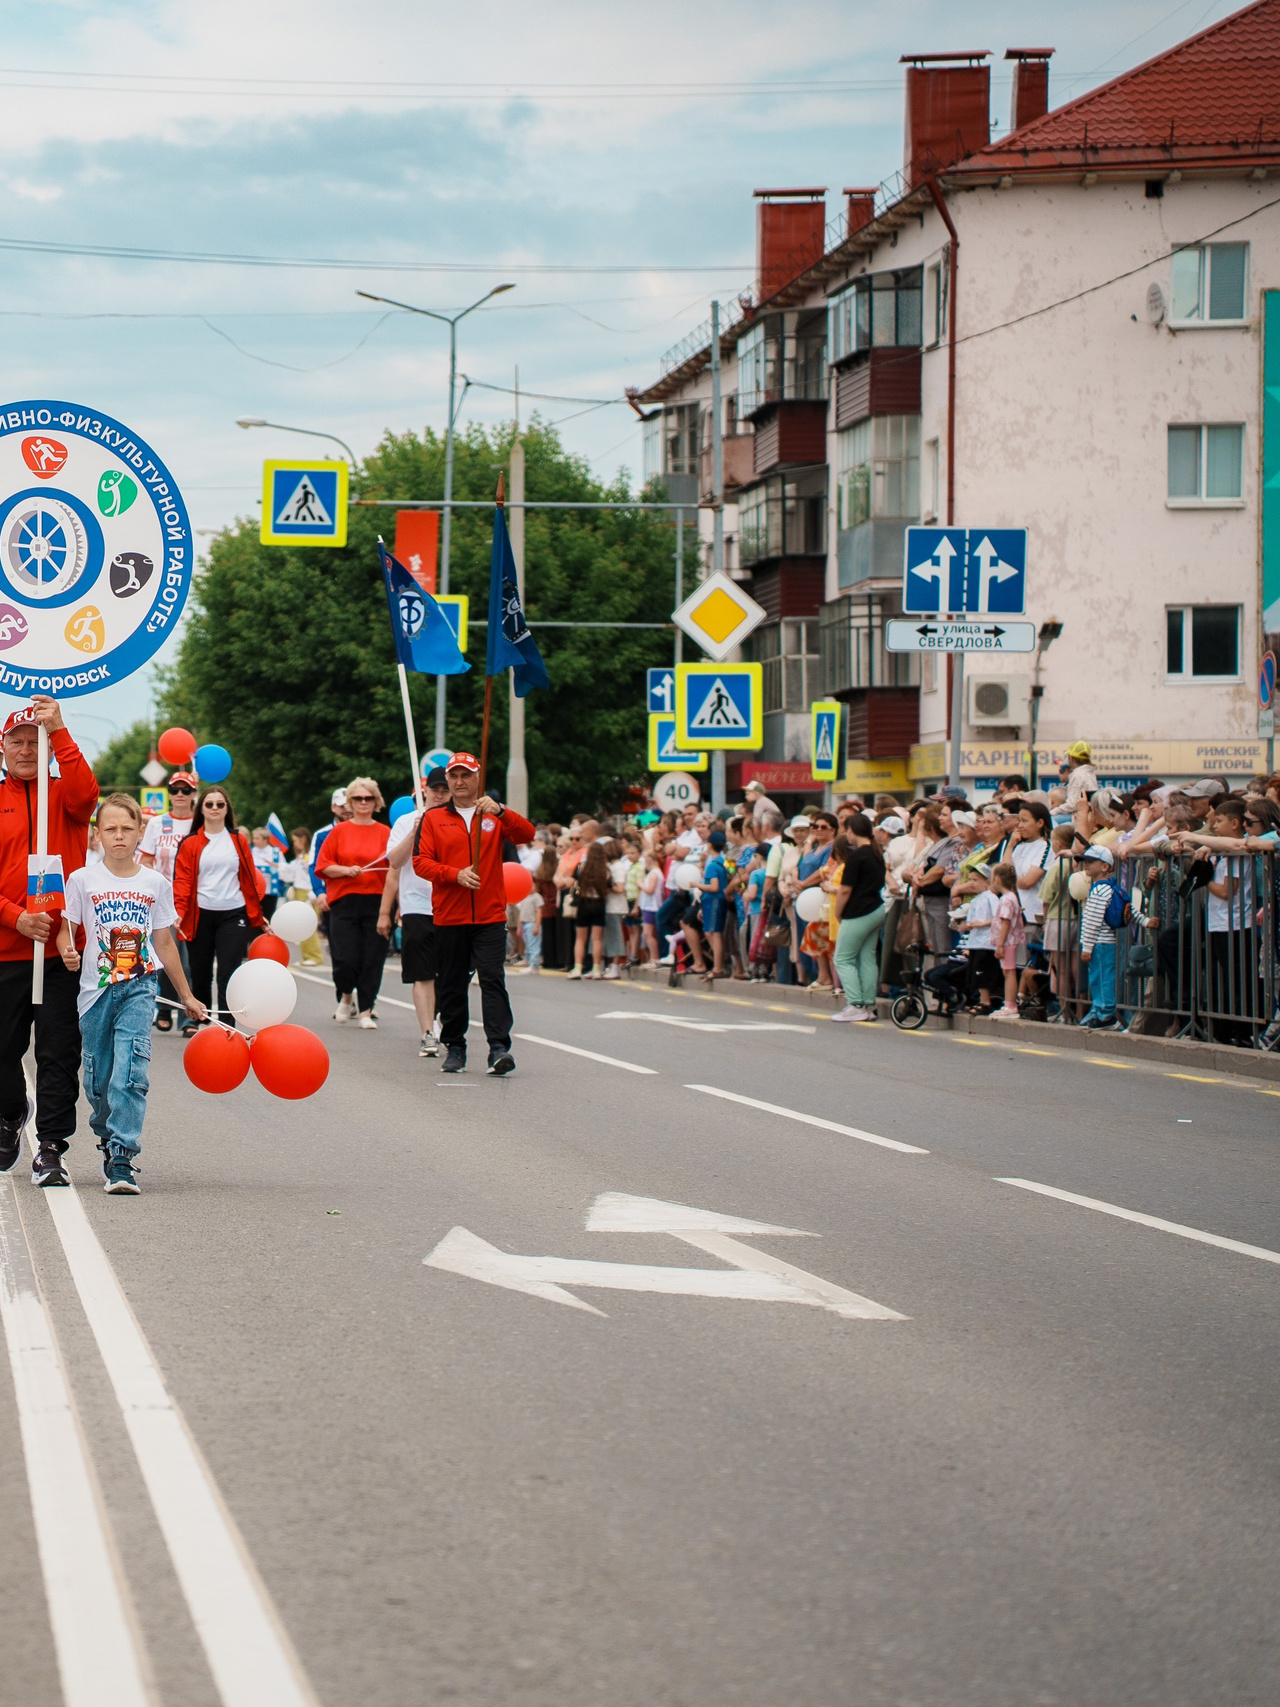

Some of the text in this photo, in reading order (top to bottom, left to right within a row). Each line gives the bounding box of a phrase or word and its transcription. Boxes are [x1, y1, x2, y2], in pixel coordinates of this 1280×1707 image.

[146, 546, 184, 634] РАБОТЕ»
[942, 625, 981, 635] улица
[918, 636, 1003, 649] СВЕРДЛОВА
[1196, 746, 1261, 756] РИМСКИЕ
[1203, 759, 1253, 769] ШТОРЫ
[665, 784, 690, 800] 40
